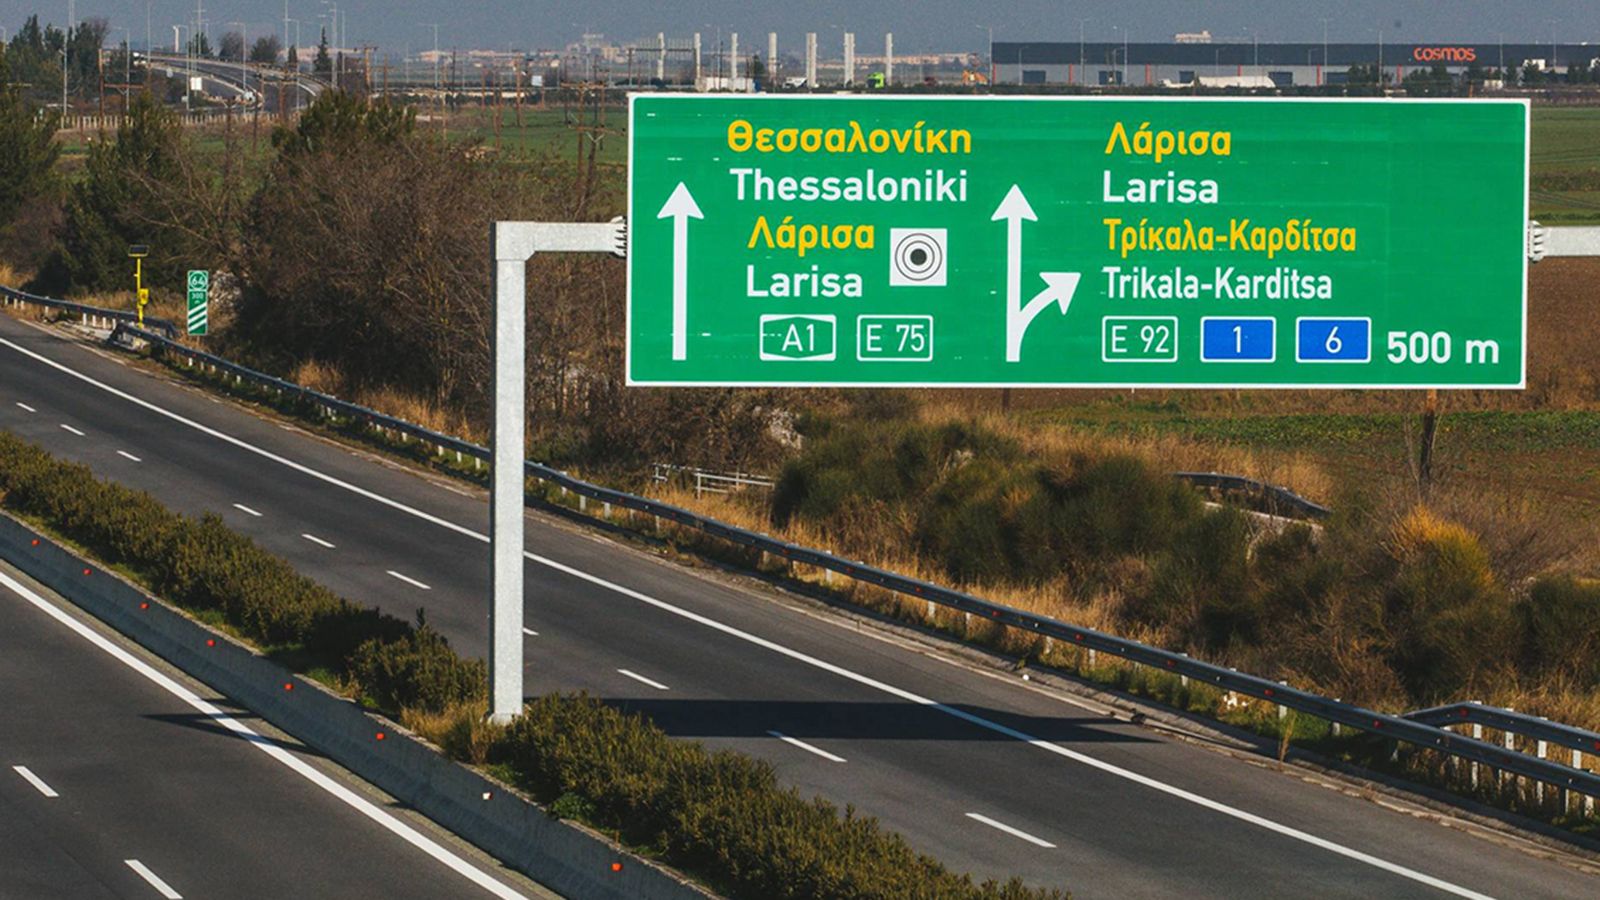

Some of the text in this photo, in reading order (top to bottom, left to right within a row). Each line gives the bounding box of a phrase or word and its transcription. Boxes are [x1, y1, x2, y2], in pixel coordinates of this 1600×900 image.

[1413, 47, 1476, 61] cosmos
[727, 119, 971, 154] Θεσσαλονίκη
[1105, 121, 1231, 163] Λάρισα
[729, 168, 967, 202] Thessaloniki
[1103, 170, 1219, 204] Larisa
[747, 215, 875, 257] Λάρισα
[1103, 218, 1356, 258] Τρίκαλα-Καρδίτσα
[746, 264, 863, 298] Larisa
[1103, 266, 1332, 299] Trikala-Karditsa
[782, 323, 815, 352] A1
[866, 324, 925, 352] E 75
[1111, 325, 1169, 353] E 92
[1233, 326, 1242, 353] 1
[1325, 326, 1342, 353] 6
[1387, 331, 1499, 364] 500 m
